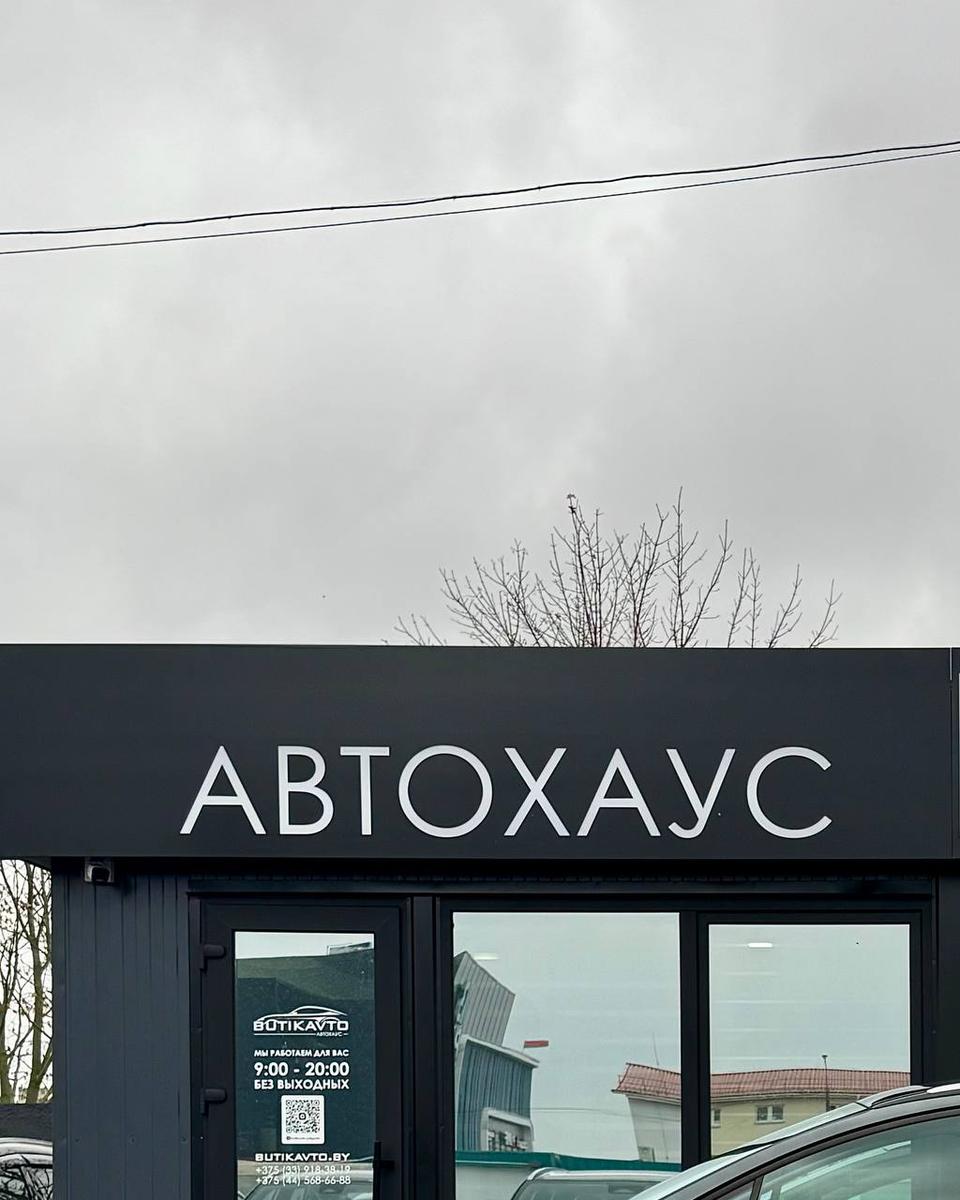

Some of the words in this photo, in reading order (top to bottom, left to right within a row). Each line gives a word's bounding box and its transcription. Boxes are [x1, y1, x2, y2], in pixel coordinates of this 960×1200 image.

[180, 745, 832, 839] АВТОХАУС
[253, 1020, 349, 1031] BUTIKAVTO
[254, 1049, 268, 1057] МЫ
[270, 1049, 312, 1057] РАБОТАЕМ
[313, 1049, 330, 1058] ДЛЯ
[332, 1049, 349, 1057] ВАС
[254, 1062, 289, 1076] 9:00
[305, 1062, 350, 1076] 20:00
[254, 1079, 274, 1090] БЕЗ
[277, 1079, 350, 1091] ВЫХОДНЫХ
[255, 1153, 350, 1161] BUTIKAVTO.BY
[256, 1165, 280, 1175] +375
[283, 1165, 300, 1177] (33)
[303, 1165, 351, 1175] 918-38-19
[256, 1175, 280, 1185] +375
[283, 1175, 300, 1187] (44)
[303, 1175, 351, 1185] 568-66-88
